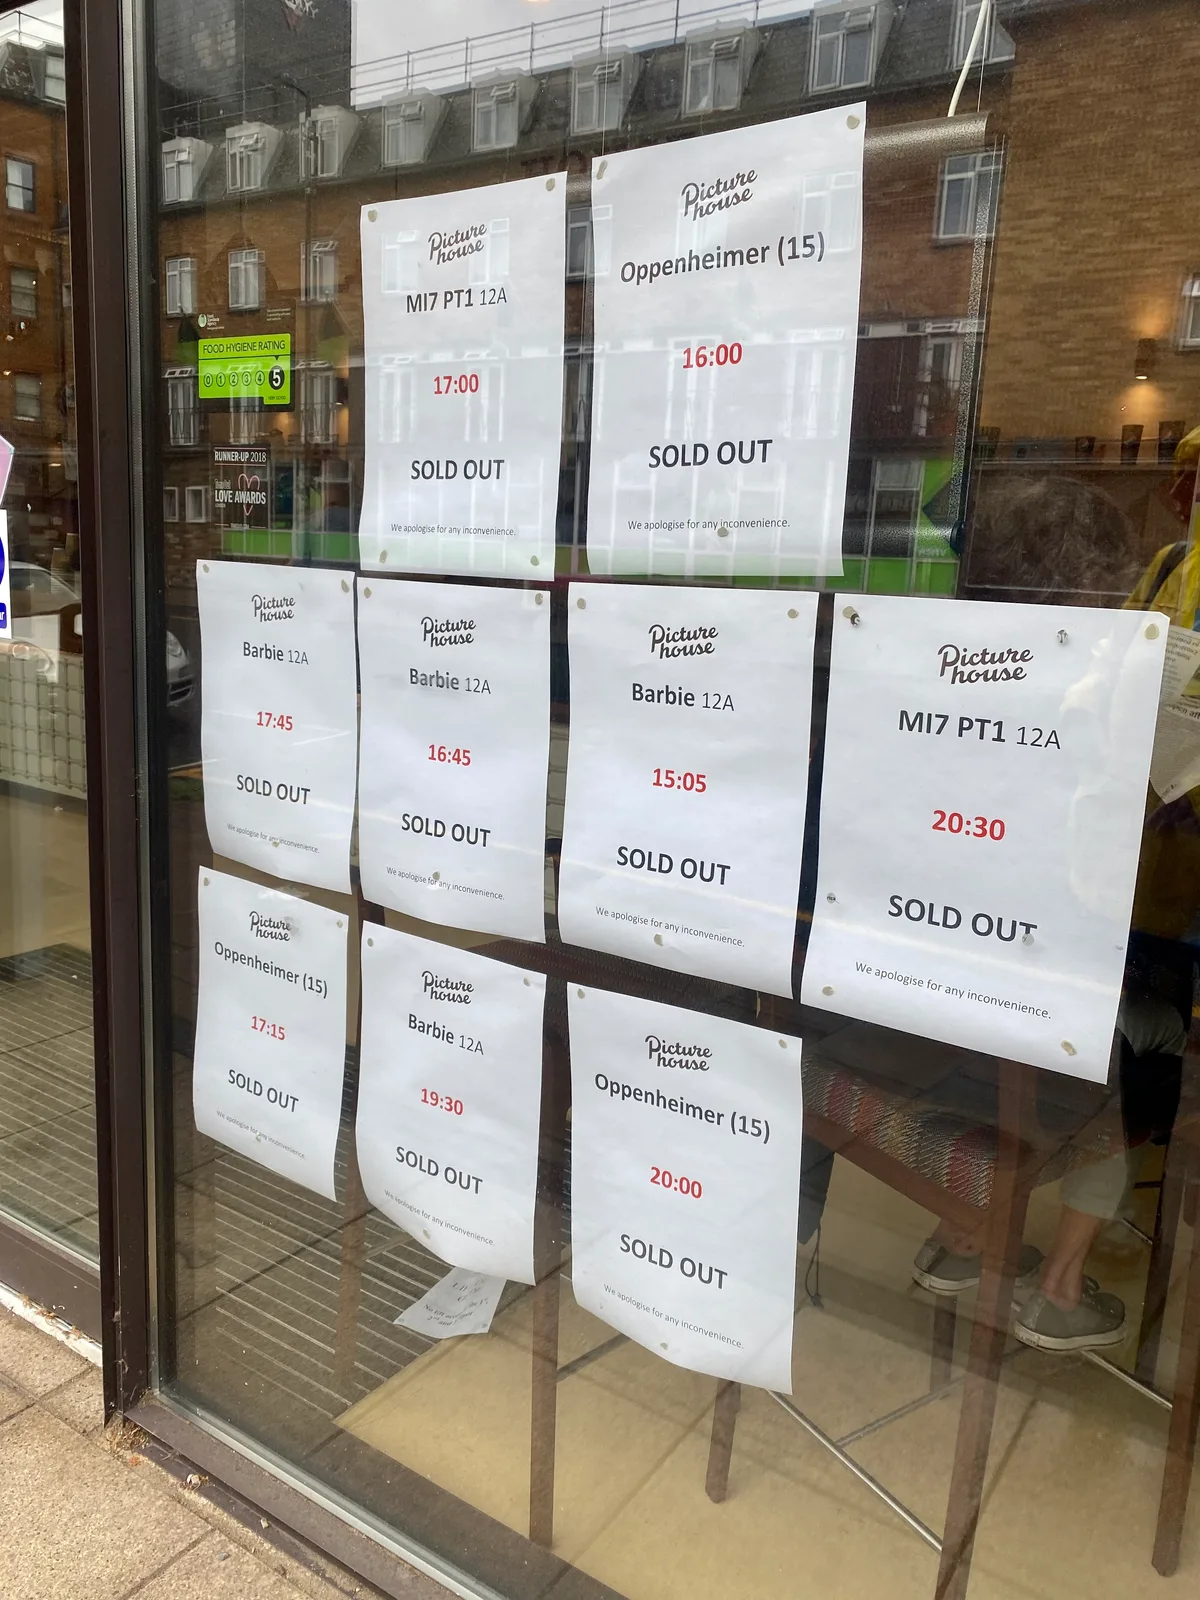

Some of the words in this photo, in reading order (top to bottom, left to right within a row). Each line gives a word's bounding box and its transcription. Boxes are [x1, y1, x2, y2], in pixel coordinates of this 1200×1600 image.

[682, 169, 757, 217] Picture
[693, 188, 753, 221] house
[428, 223, 487, 261] Picture
[437, 240, 484, 265] house
[621, 245, 770, 286] Oppenheimer
[778, 232, 825, 266] (15)
[406, 292, 438, 313] MI7
[444, 288, 473, 310] PT1
[480, 287, 507, 306] 12A
[203, 344, 224, 353] FOOD
[226, 342, 256, 352] HYGIENE
[259, 340, 285, 350] RATING
[683, 342, 742, 368] 16:00
[272, 369, 281, 387] 5
[434, 374, 479, 394] 17:00
[215, 451, 249, 461] RUNNER-UP
[251, 452, 266, 462] 2018
[649, 443, 708, 468] SOLD
[717, 439, 772, 465] OUT
[411, 460, 457, 479] SOLD
[464, 460, 504, 479] OUT
[215, 490, 232, 502] LOVE
[235, 491, 266, 504] AWARDS
[391, 524, 402, 532] We
[404, 524, 435, 534] apologise
[437, 524, 446, 533] for
[449, 527, 460, 535] any
[462, 526, 515, 536] inconvenience.
[628, 520, 642, 530] We
[644, 519, 684, 531] apologise
[687, 519, 699, 529] for
[702, 521, 718, 530] any
[721, 519, 790, 529] inconvenience.
[252, 594, 295, 617] Picture
[260, 610, 294, 622] house
[421, 617, 476, 642] Picture
[431, 633, 474, 647] house
[649, 624, 718, 653] Picture
[243, 642, 283, 661] Barbie
[288, 650, 308, 665] 12A
[660, 642, 715, 659] house
[937, 644, 1033, 677] Picture
[410, 668, 459, 690] Barbie
[465, 678, 491, 694] 12A
[951, 666, 1027, 684] house
[632, 683, 695, 706] Barbie
[702, 693, 734, 711] 12A
[257, 711, 293, 731] 17:45
[898, 710, 949, 735] MI7
[958, 716, 1005, 742] PT1
[1017, 726, 1060, 749] 12A
[428, 744, 471, 766] 16:45
[237, 775, 271, 796] SOLD
[277, 784, 310, 804] OUT
[653, 768, 706, 793] 15:05
[227, 823, 235, 831] We
[236, 827, 259, 839] apologise
[280, 838, 319, 853] inconvenience.
[402, 813, 445, 837] SOLD
[452, 824, 491, 847] OUT
[931, 810, 1005, 840] 20:30
[617, 846, 673, 874] SOLD
[681, 858, 730, 885] OUT
[387, 867, 396, 876] We
[398, 870, 426, 883] apologise
[439, 881, 450, 890] any
[452, 883, 504, 900] inconvenience.
[249, 911, 292, 931] Picture
[888, 895, 961, 929] SOLD
[256, 927, 290, 941] house
[596, 906, 609, 917] We
[611, 911, 648, 925] apologise
[650, 918, 662, 928] for
[664, 921, 679, 933] any
[681, 925, 744, 947] inconvenience.
[215, 942, 299, 984] Oppenheimer
[303, 973, 327, 999] (15)
[422, 971, 474, 992] Picture
[430, 987, 471, 1004] house
[855, 961, 872, 974] We
[875, 968, 924, 988] apologise
[927, 979, 942, 991] for
[945, 985, 964, 999] any
[967, 989, 1051, 1019] inconvenience.
[251, 1016, 285, 1040] 17:15
[408, 1013, 454, 1044] Barbie
[459, 1035, 484, 1055] 12A
[645, 1035, 712, 1059] Picture
[657, 1052, 709, 1071] house
[229, 1069, 262, 1096] SOLD
[267, 1088, 299, 1112] OUT
[421, 1088, 463, 1115] 19:30
[595, 1073, 724, 1126] Oppenheimer
[730, 1112, 770, 1144] (15)
[396, 1146, 439, 1177] SOLD
[445, 1167, 483, 1194] OUT
[650, 1166, 702, 1199] 20:00
[384, 1189, 394, 1200] We
[395, 1196, 420, 1215] apologise
[421, 1209, 430, 1219] for
[432, 1216, 443, 1227] any
[445, 1221, 495, 1247] inconvenience.
[620, 1234, 673, 1269] SOLD
[680, 1258, 727, 1289] OUT
[604, 1284, 616, 1296] We
[617, 1292, 650, 1313] apologise
[652, 1307, 663, 1319] for
[665, 1314, 679, 1326] any
[681, 1320, 744, 1349] inconvenience.
